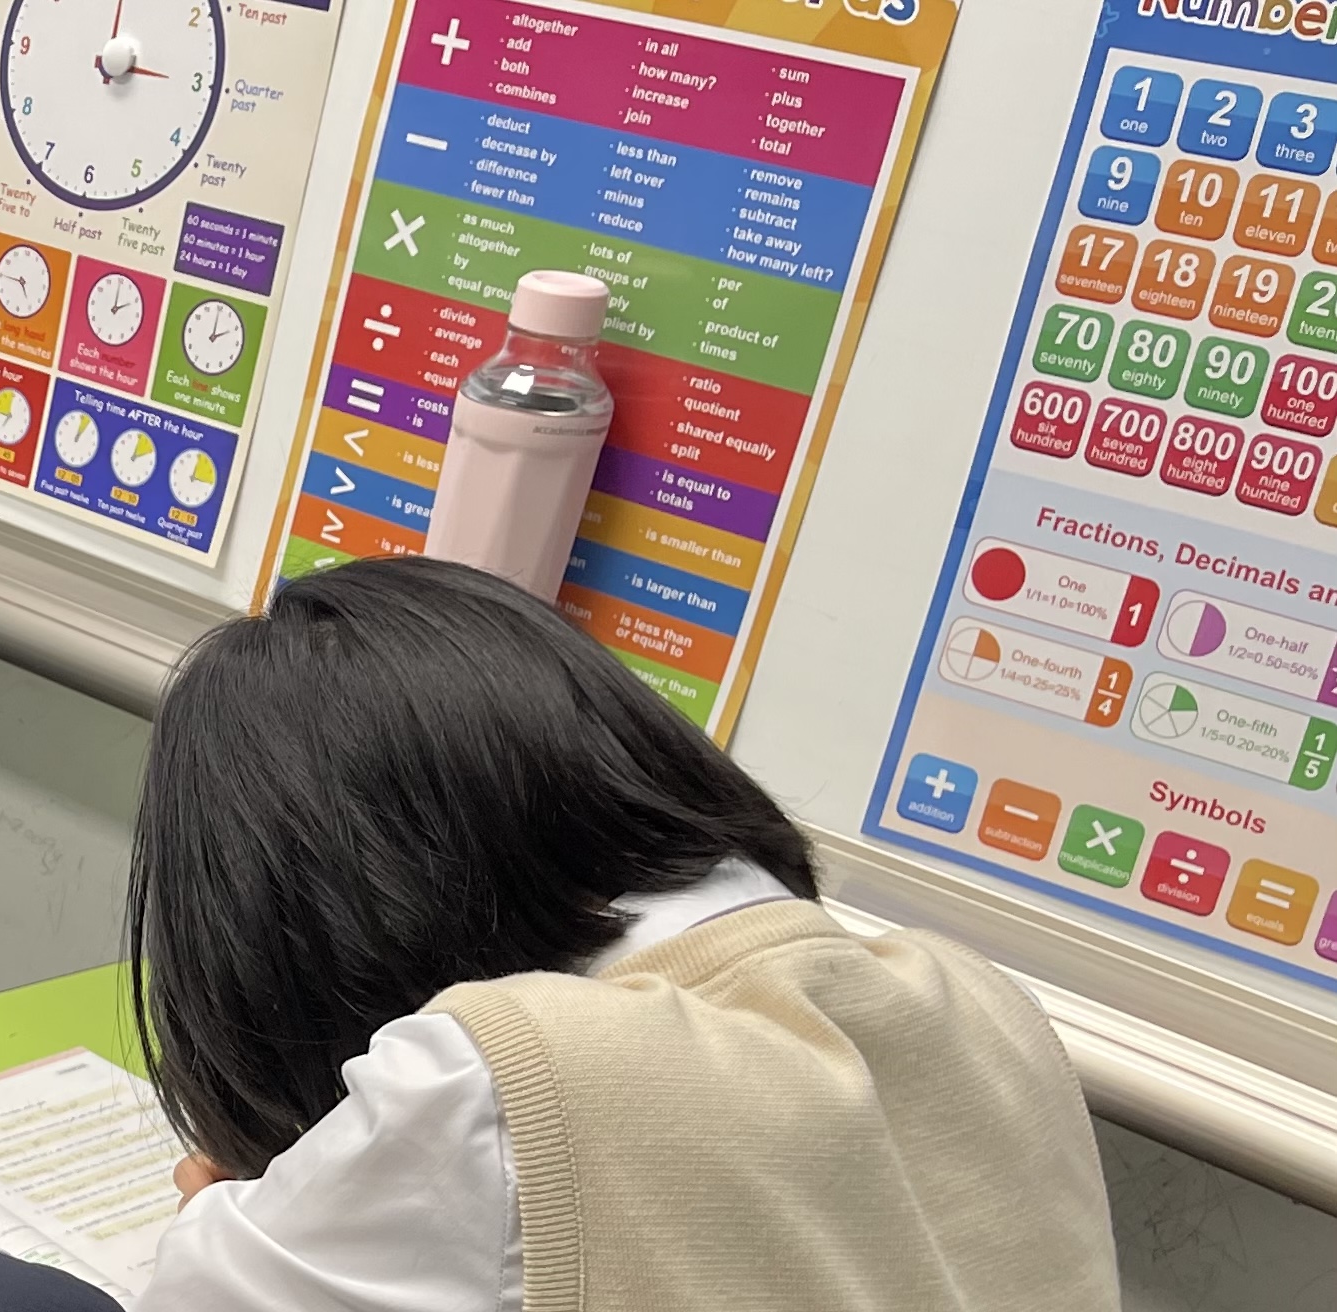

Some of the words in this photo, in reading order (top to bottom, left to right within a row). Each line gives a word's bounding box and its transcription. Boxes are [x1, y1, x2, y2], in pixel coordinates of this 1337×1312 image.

[189, 7, 200, 27] 2
[239, 3, 258, 20] Ten
[261, 11, 287, 25] past
[512, 14, 578, 37] altogether
[21, 36, 30, 54] 9
[507, 38, 532, 52] add
[645, 37, 658, 53] in
[661, 42, 678, 57] all
[501, 58, 529, 75] both
[639, 62, 667, 80] how
[670, 71, 717, 91] many?
[779, 68, 809, 83] sum
[192, 72, 203, 92] 3
[235, 79, 283, 100] Quarter
[495, 82, 556, 104] combines
[23, 97, 32, 115] 8
[230, 99, 256, 112] past
[632, 86, 689, 109] increase
[771, 91, 802, 109] plus
[1134, 77, 1152, 112] 1
[624, 107, 651, 125] join
[1208, 91, 1237, 126] 2
[487, 114, 531, 134] deduct
[766, 114, 825, 138] together
[1120, 119, 1148, 133] one
[1291, 104, 1318, 139] 3
[759, 137, 792, 155] total
[1201, 131, 1227, 147] two
[45, 142, 55, 160] 7
[482, 136, 537, 159] decrease
[541, 148, 557, 166] by
[617, 141, 643, 159] less
[647, 148, 677, 167] than
[1276, 144, 1315, 163] three
[84, 165, 95, 183] 6
[207, 154, 246, 177] Twenty
[477, 159, 537, 183] difference
[610, 165, 632, 182] left
[634, 173, 665, 189] over
[1108, 156, 1133, 190] 9
[200, 173, 226, 187] past
[750, 169, 803, 190] remove
[1177, 169, 1223, 207] 10
[471, 180, 505, 199] fewer
[507, 188, 535, 206] than
[605, 189, 644, 209] minus
[744, 188, 800, 210] remains
[1097, 196, 1129, 213] nine
[1259, 184, 1304, 223] 11
[53, 217, 77, 234] Half
[78, 226, 103, 240] past
[187, 214, 199, 225] 60
[200, 220, 233, 236] seconds
[249, 231, 278, 246] minute
[463, 214, 477, 226] as
[480, 218, 515, 235] much
[598, 212, 643, 232] reduce
[739, 207, 797, 230] subtract
[1180, 213, 1203, 227] ten
[458, 233, 521, 257] altogether
[733, 226, 762, 244] take
[766, 236, 802, 256] away
[1245, 224, 1296, 245] eleven
[454, 253, 469, 270] by
[590, 243, 613, 260] lots
[617, 251, 632, 264] of
[727, 246, 756, 264] how
[759, 255, 798, 277] many
[801, 263, 833, 282] left?
[1077, 234, 1125, 271] 17
[585, 266, 629, 285] groups
[632, 275, 648, 289] of
[1154, 249, 1199, 287] 18
[448, 274, 481, 292] equal
[717, 278, 742, 291] per
[1060, 273, 1123, 294] seventeen
[1232, 265, 1278, 303] 19
[713, 298, 728, 310] of
[1139, 288, 1196, 310] eighteen
[440, 308, 476, 327] divide
[1214, 304, 1278, 328] nineteen
[435, 327, 482, 349] average
[705, 322, 760, 344] product
[763, 335, 779, 348] of
[1054, 312, 1101, 350] 70
[430, 351, 459, 367] each
[700, 342, 737, 361] times
[1128, 330, 1177, 368] 80
[1039, 351, 1096, 374] seventy
[1205, 345, 1255, 385] 90
[424, 372, 457, 389] equal
[690, 377, 721, 394] ratio
[1122, 370, 1166, 390] eighty
[1279, 362, 1337, 401] 100
[417, 399, 450, 415] costs
[684, 398, 740, 421] quotient
[1022, 388, 1083, 424] 600
[1197, 387, 1243, 409] ninety
[75, 390, 103, 413] Telling
[106, 402, 125, 416] time
[128, 409, 161, 428] AFTER
[164, 420, 179, 434] the
[181, 425, 204, 441] hour
[1099, 405, 1161, 443] 700
[670, 443, 700, 460] split
[677, 422, 724, 444] shared
[726, 434, 776, 461] equally
[1173, 423, 1236, 461] 800
[1250, 441, 1315, 481] 900
[662, 470, 674, 484] is
[677, 476, 715, 497] equal
[717, 487, 731, 501] to
[657, 489, 694, 511] totals
[645, 528, 657, 541] is
[661, 533, 709, 557] smaller
[712, 549, 742, 568] than
[1036, 507, 1165, 562] Fractions,
[1174, 543, 1299, 595] Decimals
[631, 574, 643, 587] is
[646, 579, 685, 601] larger
[687, 593, 716, 612] than
[1058, 575, 1087, 593] One
[620, 612, 632, 627] is
[635, 617, 661, 637] less
[664, 628, 693, 648] than
[1244, 626, 1310, 655] One-half
[1011, 649, 1083, 679] One-fourth
[1216, 709, 1278, 737] One-fifth
[908, 800, 955, 823] addition
[1149, 781, 1267, 835] Symbols
[1157, 881, 1200, 904] division
